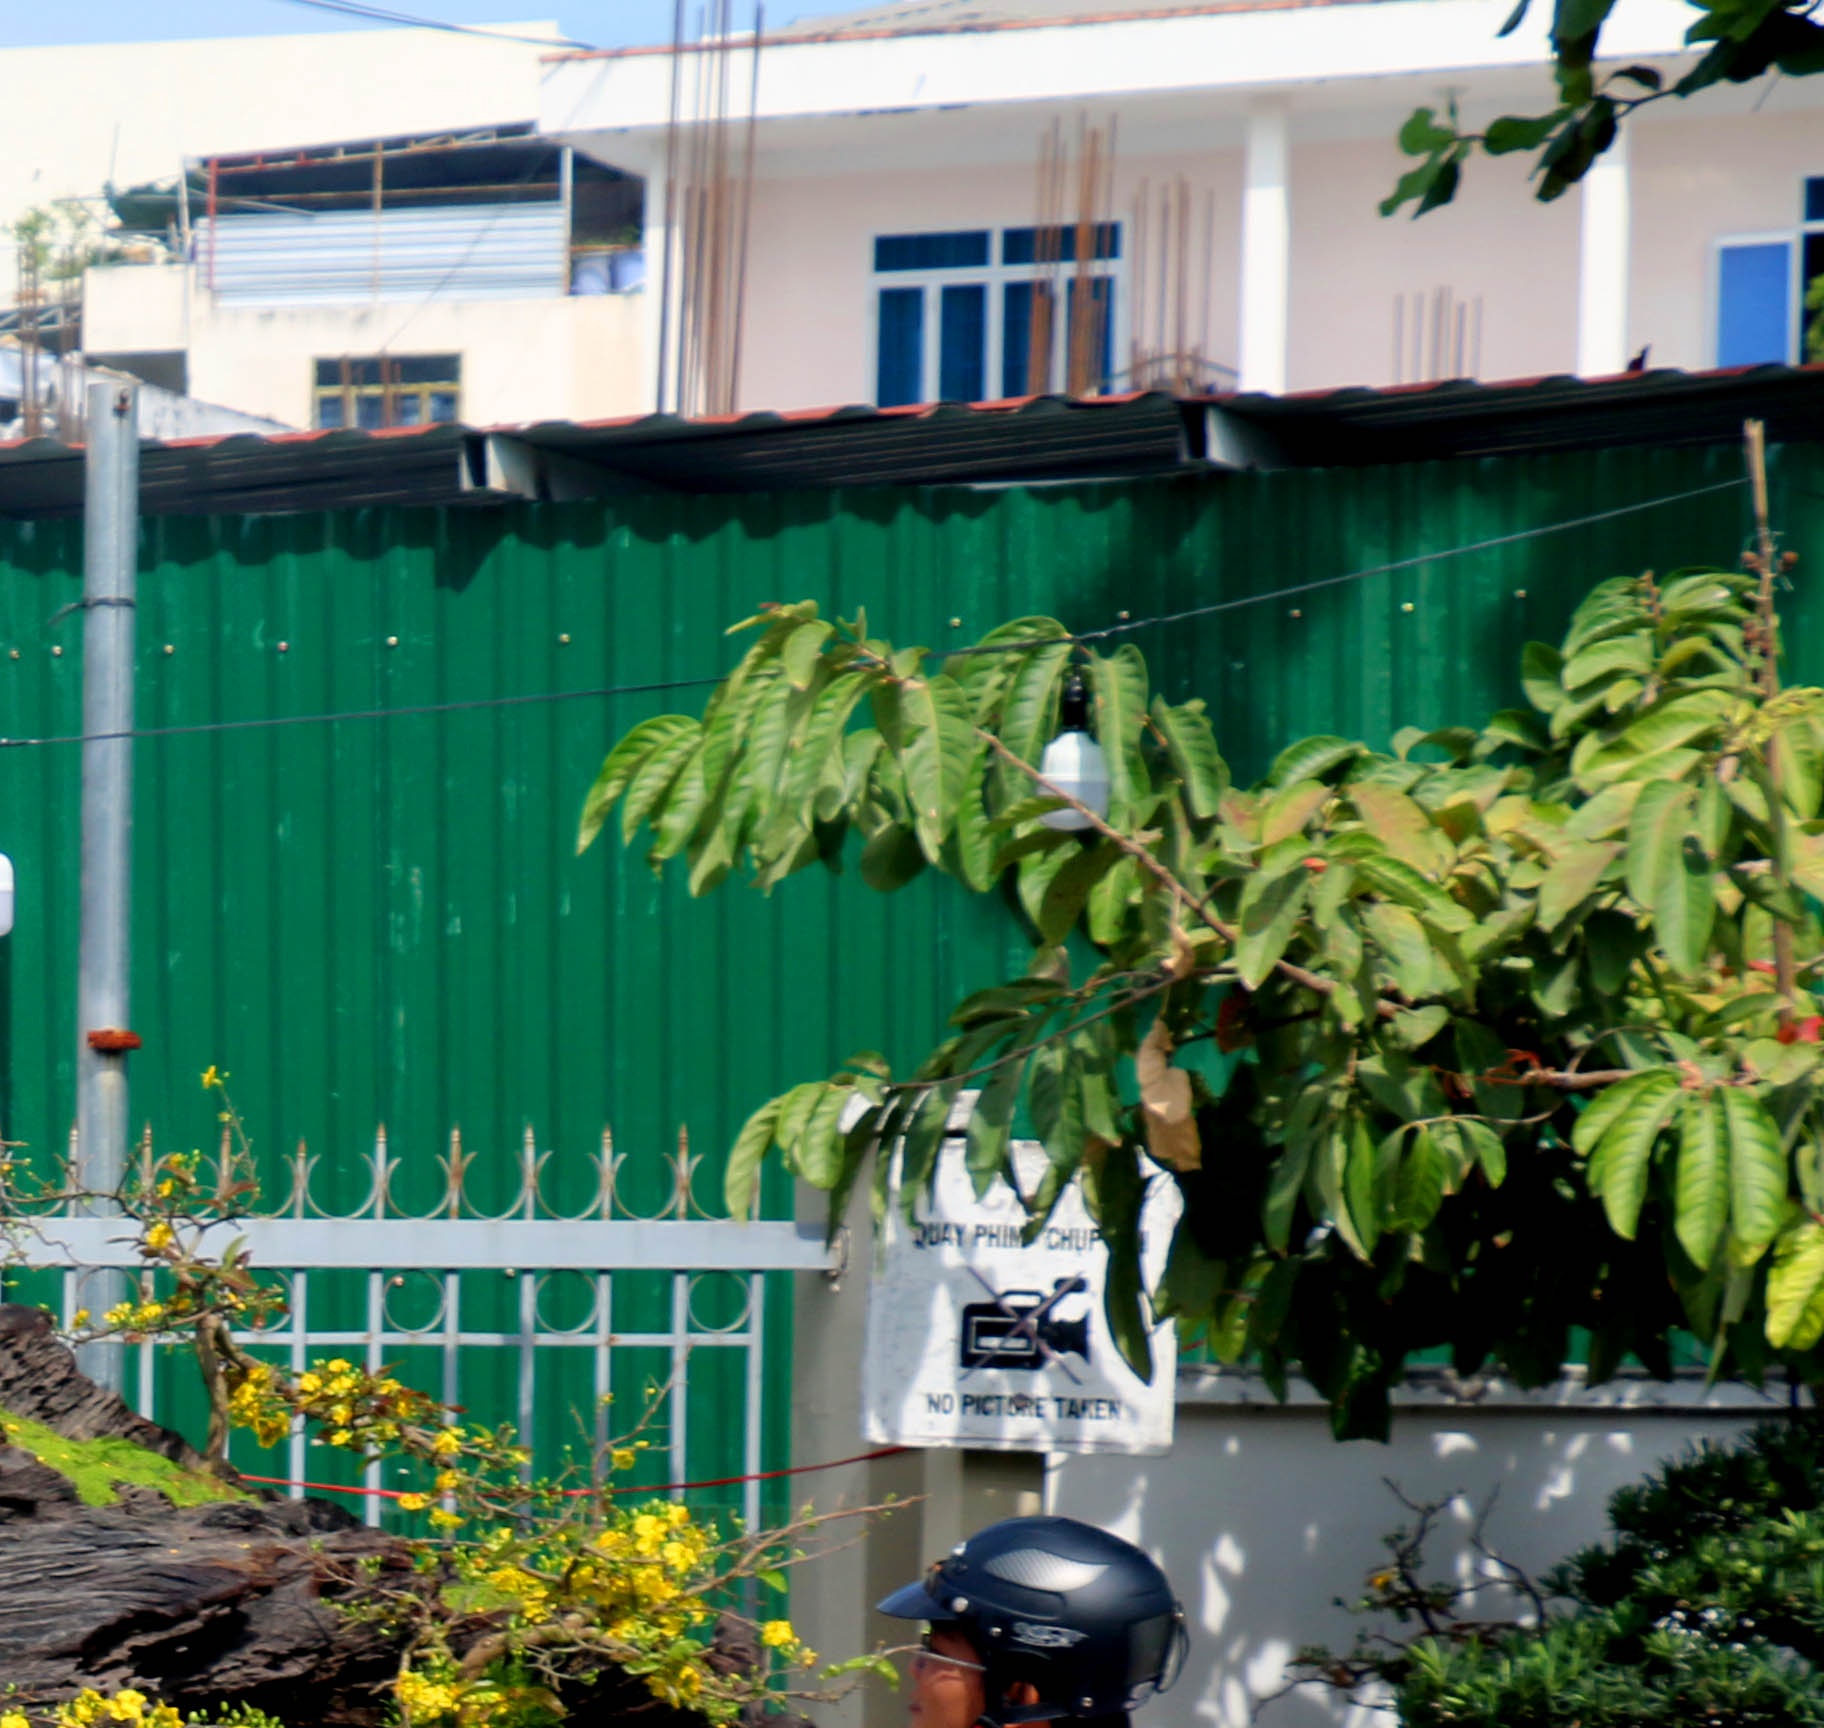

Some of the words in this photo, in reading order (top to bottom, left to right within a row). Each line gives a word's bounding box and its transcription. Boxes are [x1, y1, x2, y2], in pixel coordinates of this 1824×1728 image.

[912, 1222, 967, 1251] QUAY
[926, 1393, 954, 1415] NO
[1054, 1396, 1122, 1421] TAKEN
